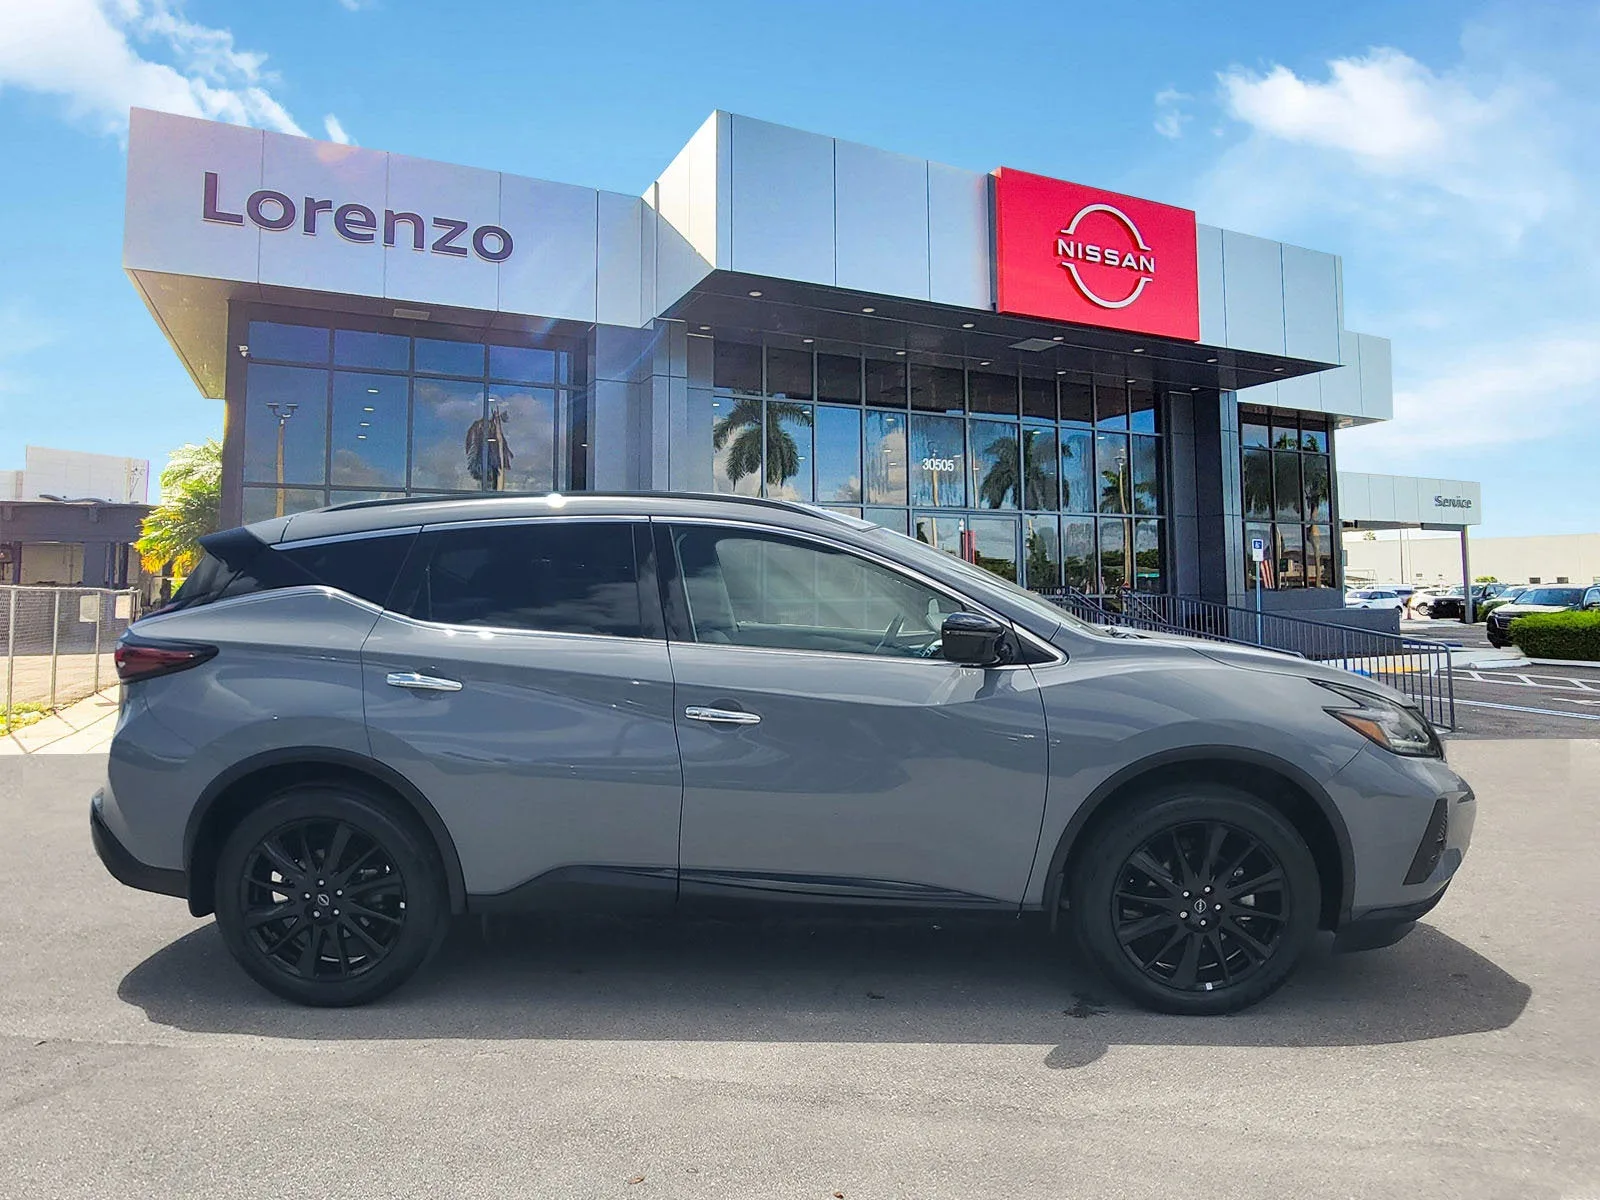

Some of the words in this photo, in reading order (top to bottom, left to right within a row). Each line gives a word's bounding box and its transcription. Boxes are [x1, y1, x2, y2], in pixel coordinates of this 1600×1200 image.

[202, 171, 514, 263] Lorenzo
[1057, 238, 1155, 273] NISSAN
[922, 458, 954, 471] 30505
[1435, 495, 1472, 508] Service
